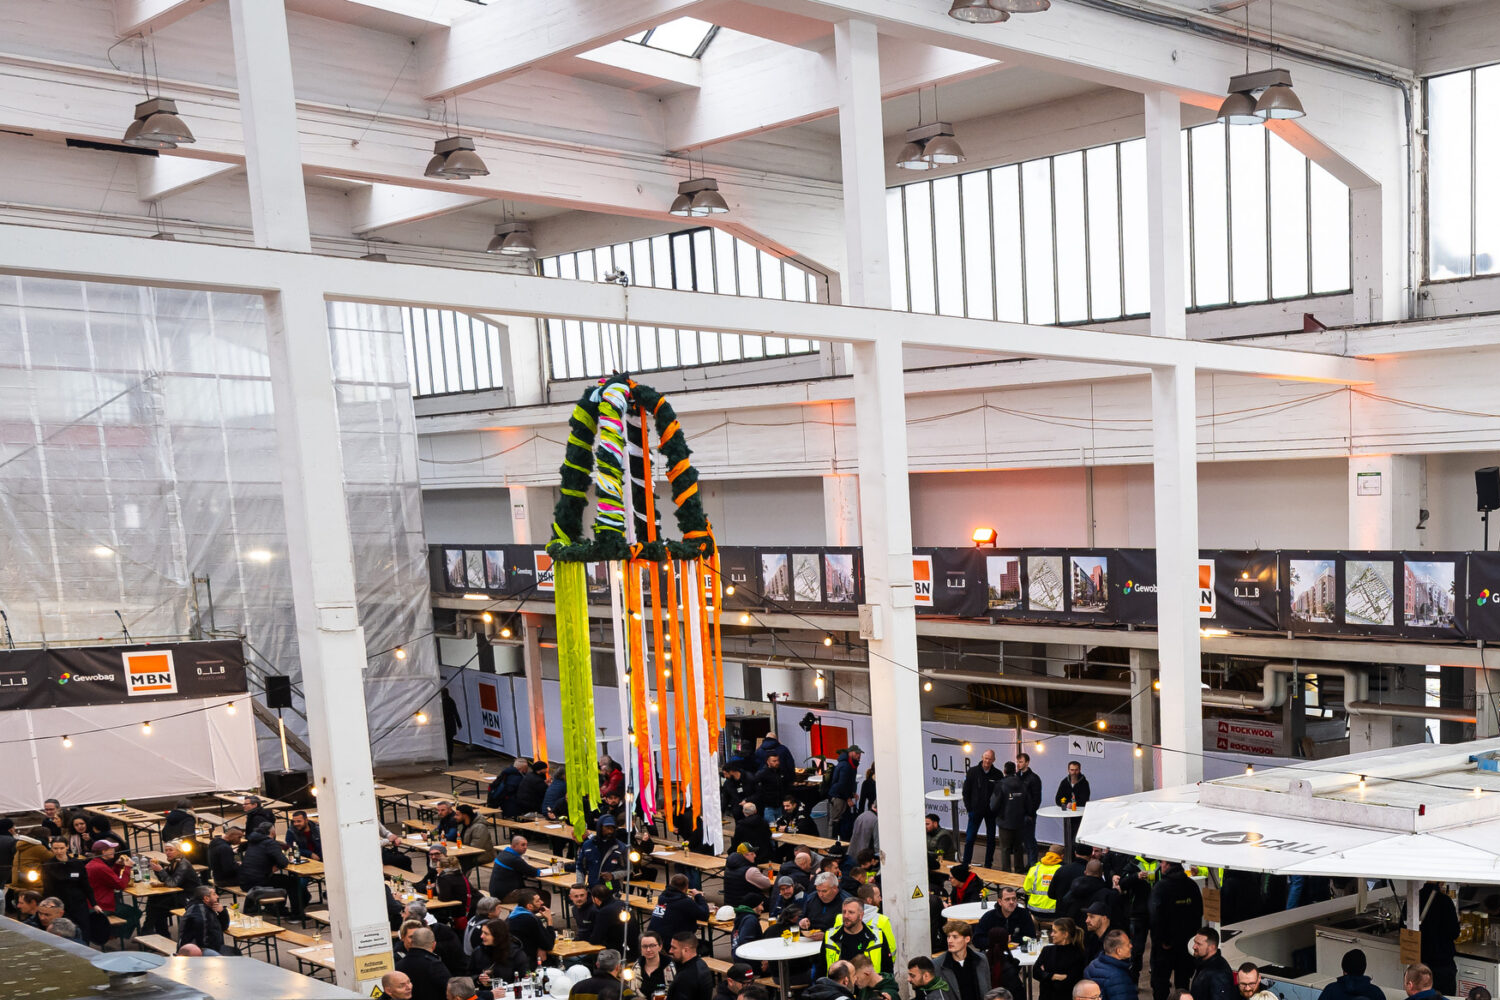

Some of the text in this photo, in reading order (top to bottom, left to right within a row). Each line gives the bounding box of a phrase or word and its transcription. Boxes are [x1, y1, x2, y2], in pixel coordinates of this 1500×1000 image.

[914, 581, 930, 595] BN
[1134, 583, 1158, 593] Gewob
[73, 673, 115, 683] Gewobag
[130, 673, 171, 686] MBN
[482, 711, 501, 729] MBN
[1230, 725, 1275, 738] ROCKWOOL
[1086, 740, 1103, 754] WC
[1230, 742, 1275, 755] ROCKWOOL
[1135, 821, 1328, 855] LAST CALL
